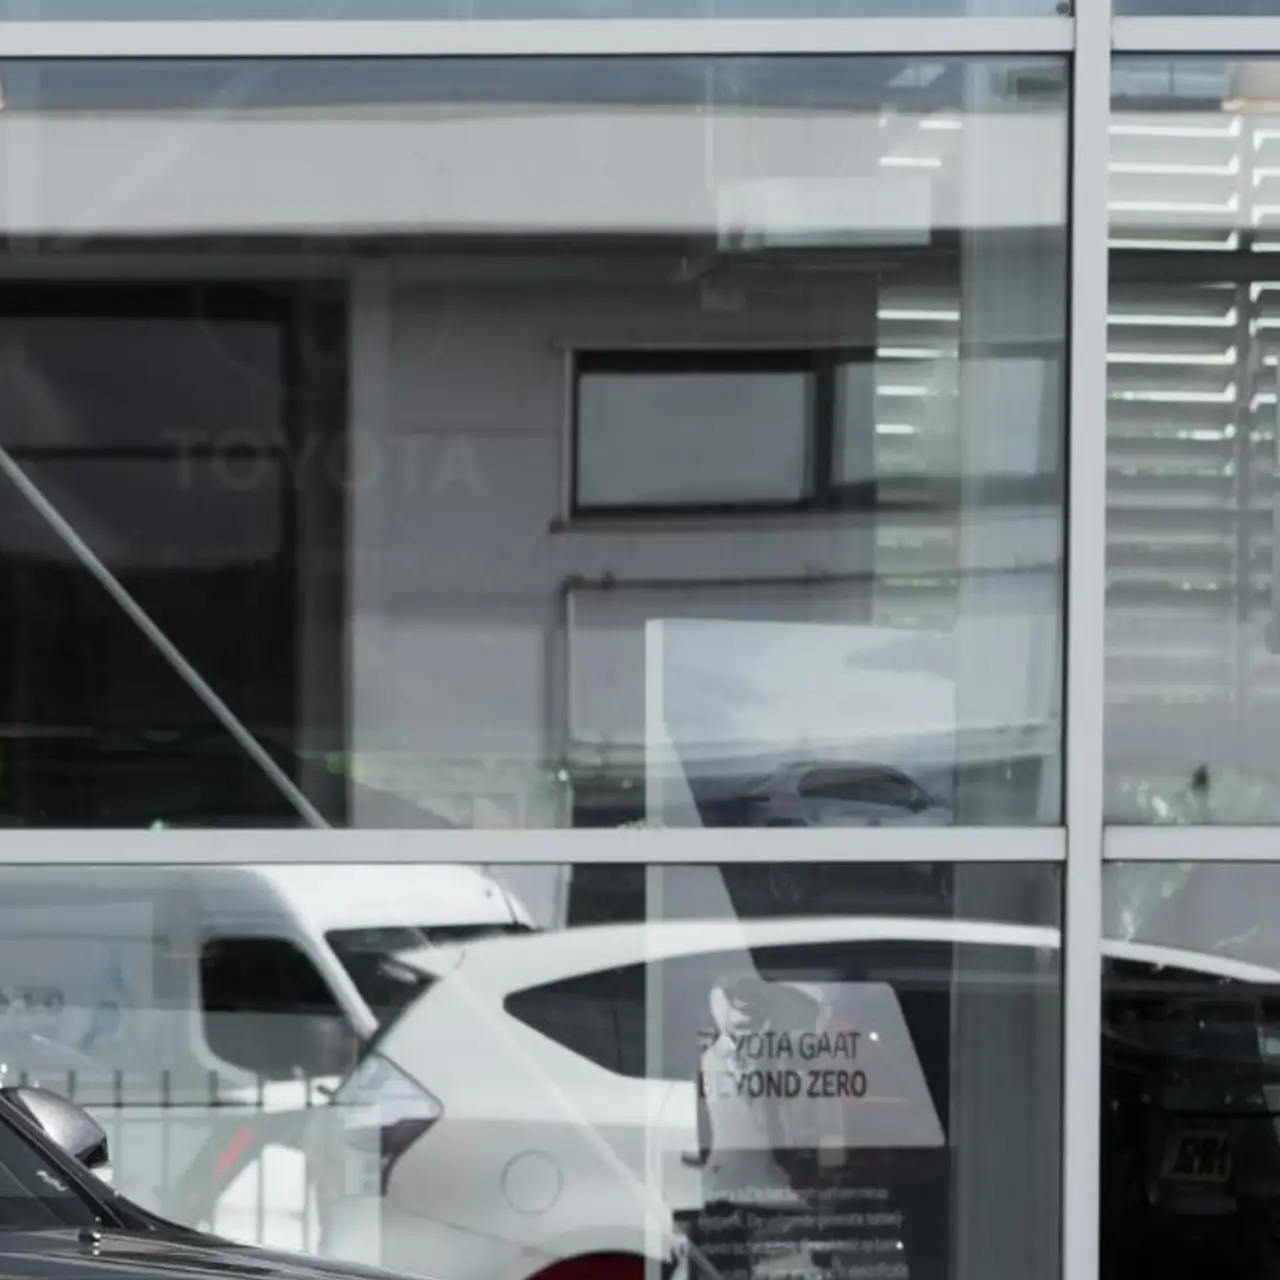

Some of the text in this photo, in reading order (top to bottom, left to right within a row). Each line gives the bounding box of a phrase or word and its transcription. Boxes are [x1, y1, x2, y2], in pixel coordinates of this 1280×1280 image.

[160, 427, 496, 496] TOYOTA
[798, 1031, 861, 1061] GAAT
[806, 1069, 867, 1099] ZERO
